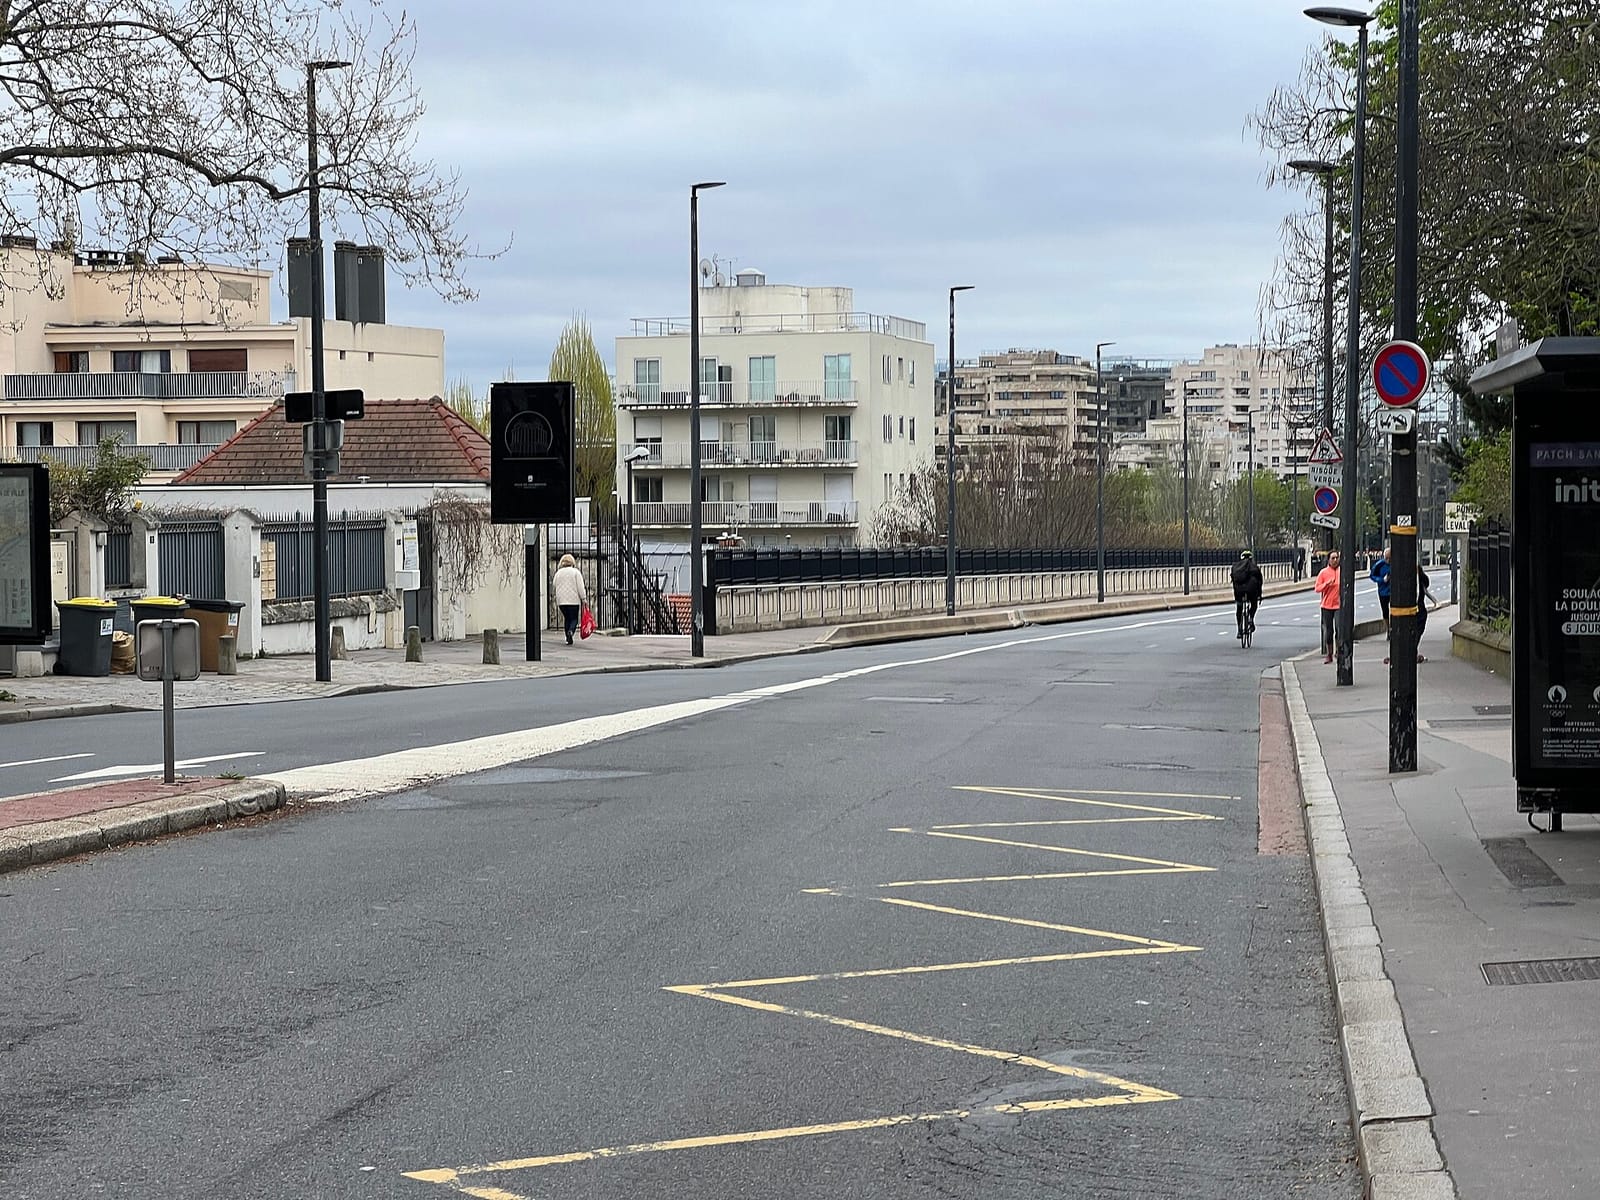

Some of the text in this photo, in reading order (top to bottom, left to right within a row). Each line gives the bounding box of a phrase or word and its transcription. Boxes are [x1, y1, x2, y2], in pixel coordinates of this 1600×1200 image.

[1536, 449, 1573, 460] PATCH
[1313, 475, 1342, 485] VERGLA
[1555, 477, 1600, 503] init
[1555, 600, 1600, 612] LA DOUL
[1566, 623, 1572, 634] 5
